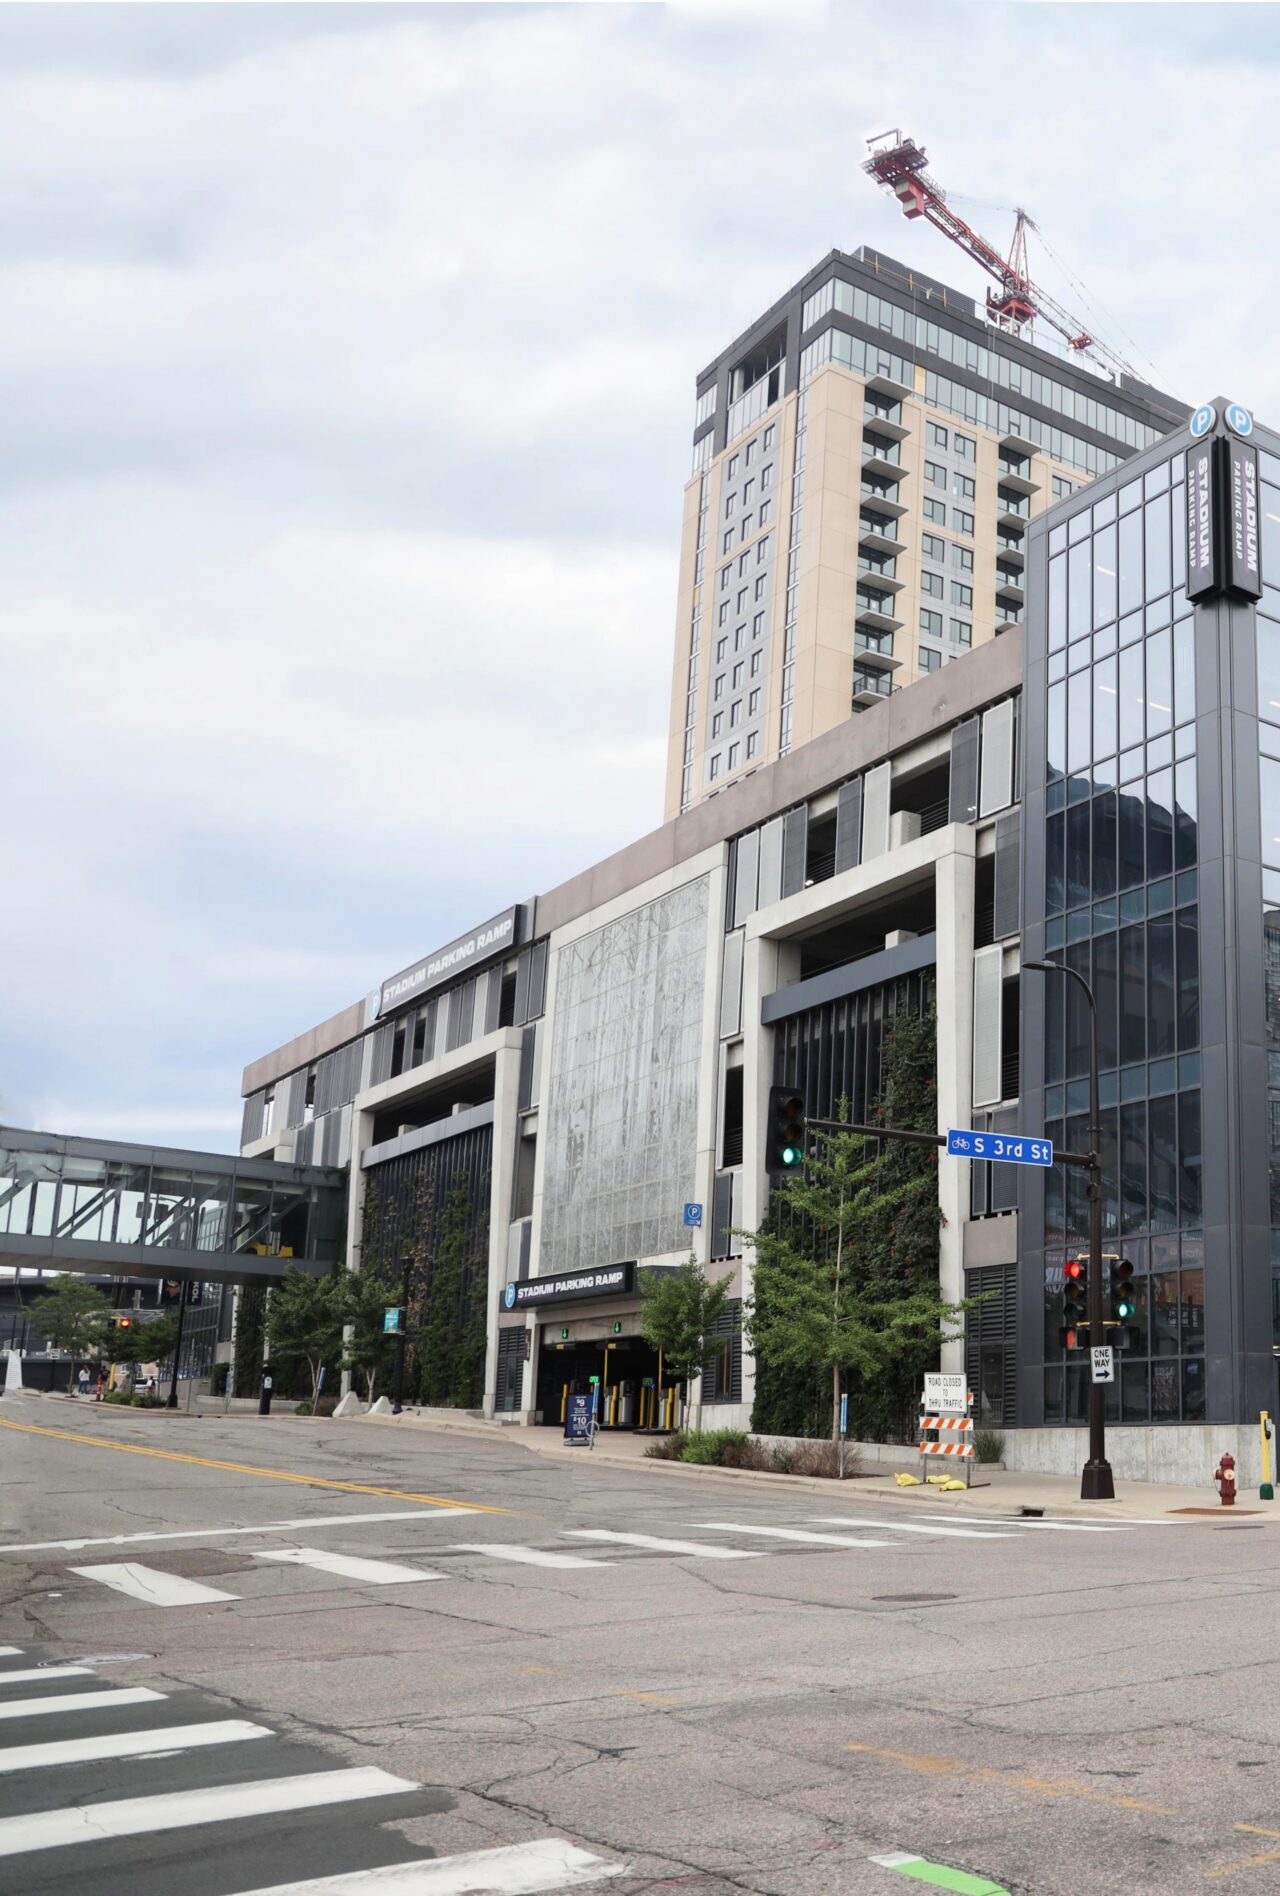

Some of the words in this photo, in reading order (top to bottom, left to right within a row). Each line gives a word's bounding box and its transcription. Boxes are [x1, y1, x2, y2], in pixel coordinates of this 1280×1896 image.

[1188, 470, 1196, 527] PARKING
[1233, 461, 1242, 518] PARKING
[1199, 457, 1209, 569] STADIUM
[1245, 460, 1257, 572] STADIUM
[1235, 522, 1243, 560] RAMP
[383, 967, 426, 1003] STADIUM
[427, 940, 475, 978] PARKING
[477, 918, 512, 950] RAMP
[974, 1138, 985, 1153] S
[994, 1140, 1023, 1157] 3rd
[1031, 1145, 1049, 1160] St
[518, 1283, 554, 1298] STADIUM
[555, 1276, 594, 1293] PARKING
[595, 1271, 623, 1287] RAMP
[1094, 1349, 1110, 1358] ONE
[1094, 1359, 1110, 1367] WAY
[943, 1377, 962, 1387] CLOSED
[943, 1399, 962, 1409] TRAFFIC
[573, 1416, 587, 1425] $10
